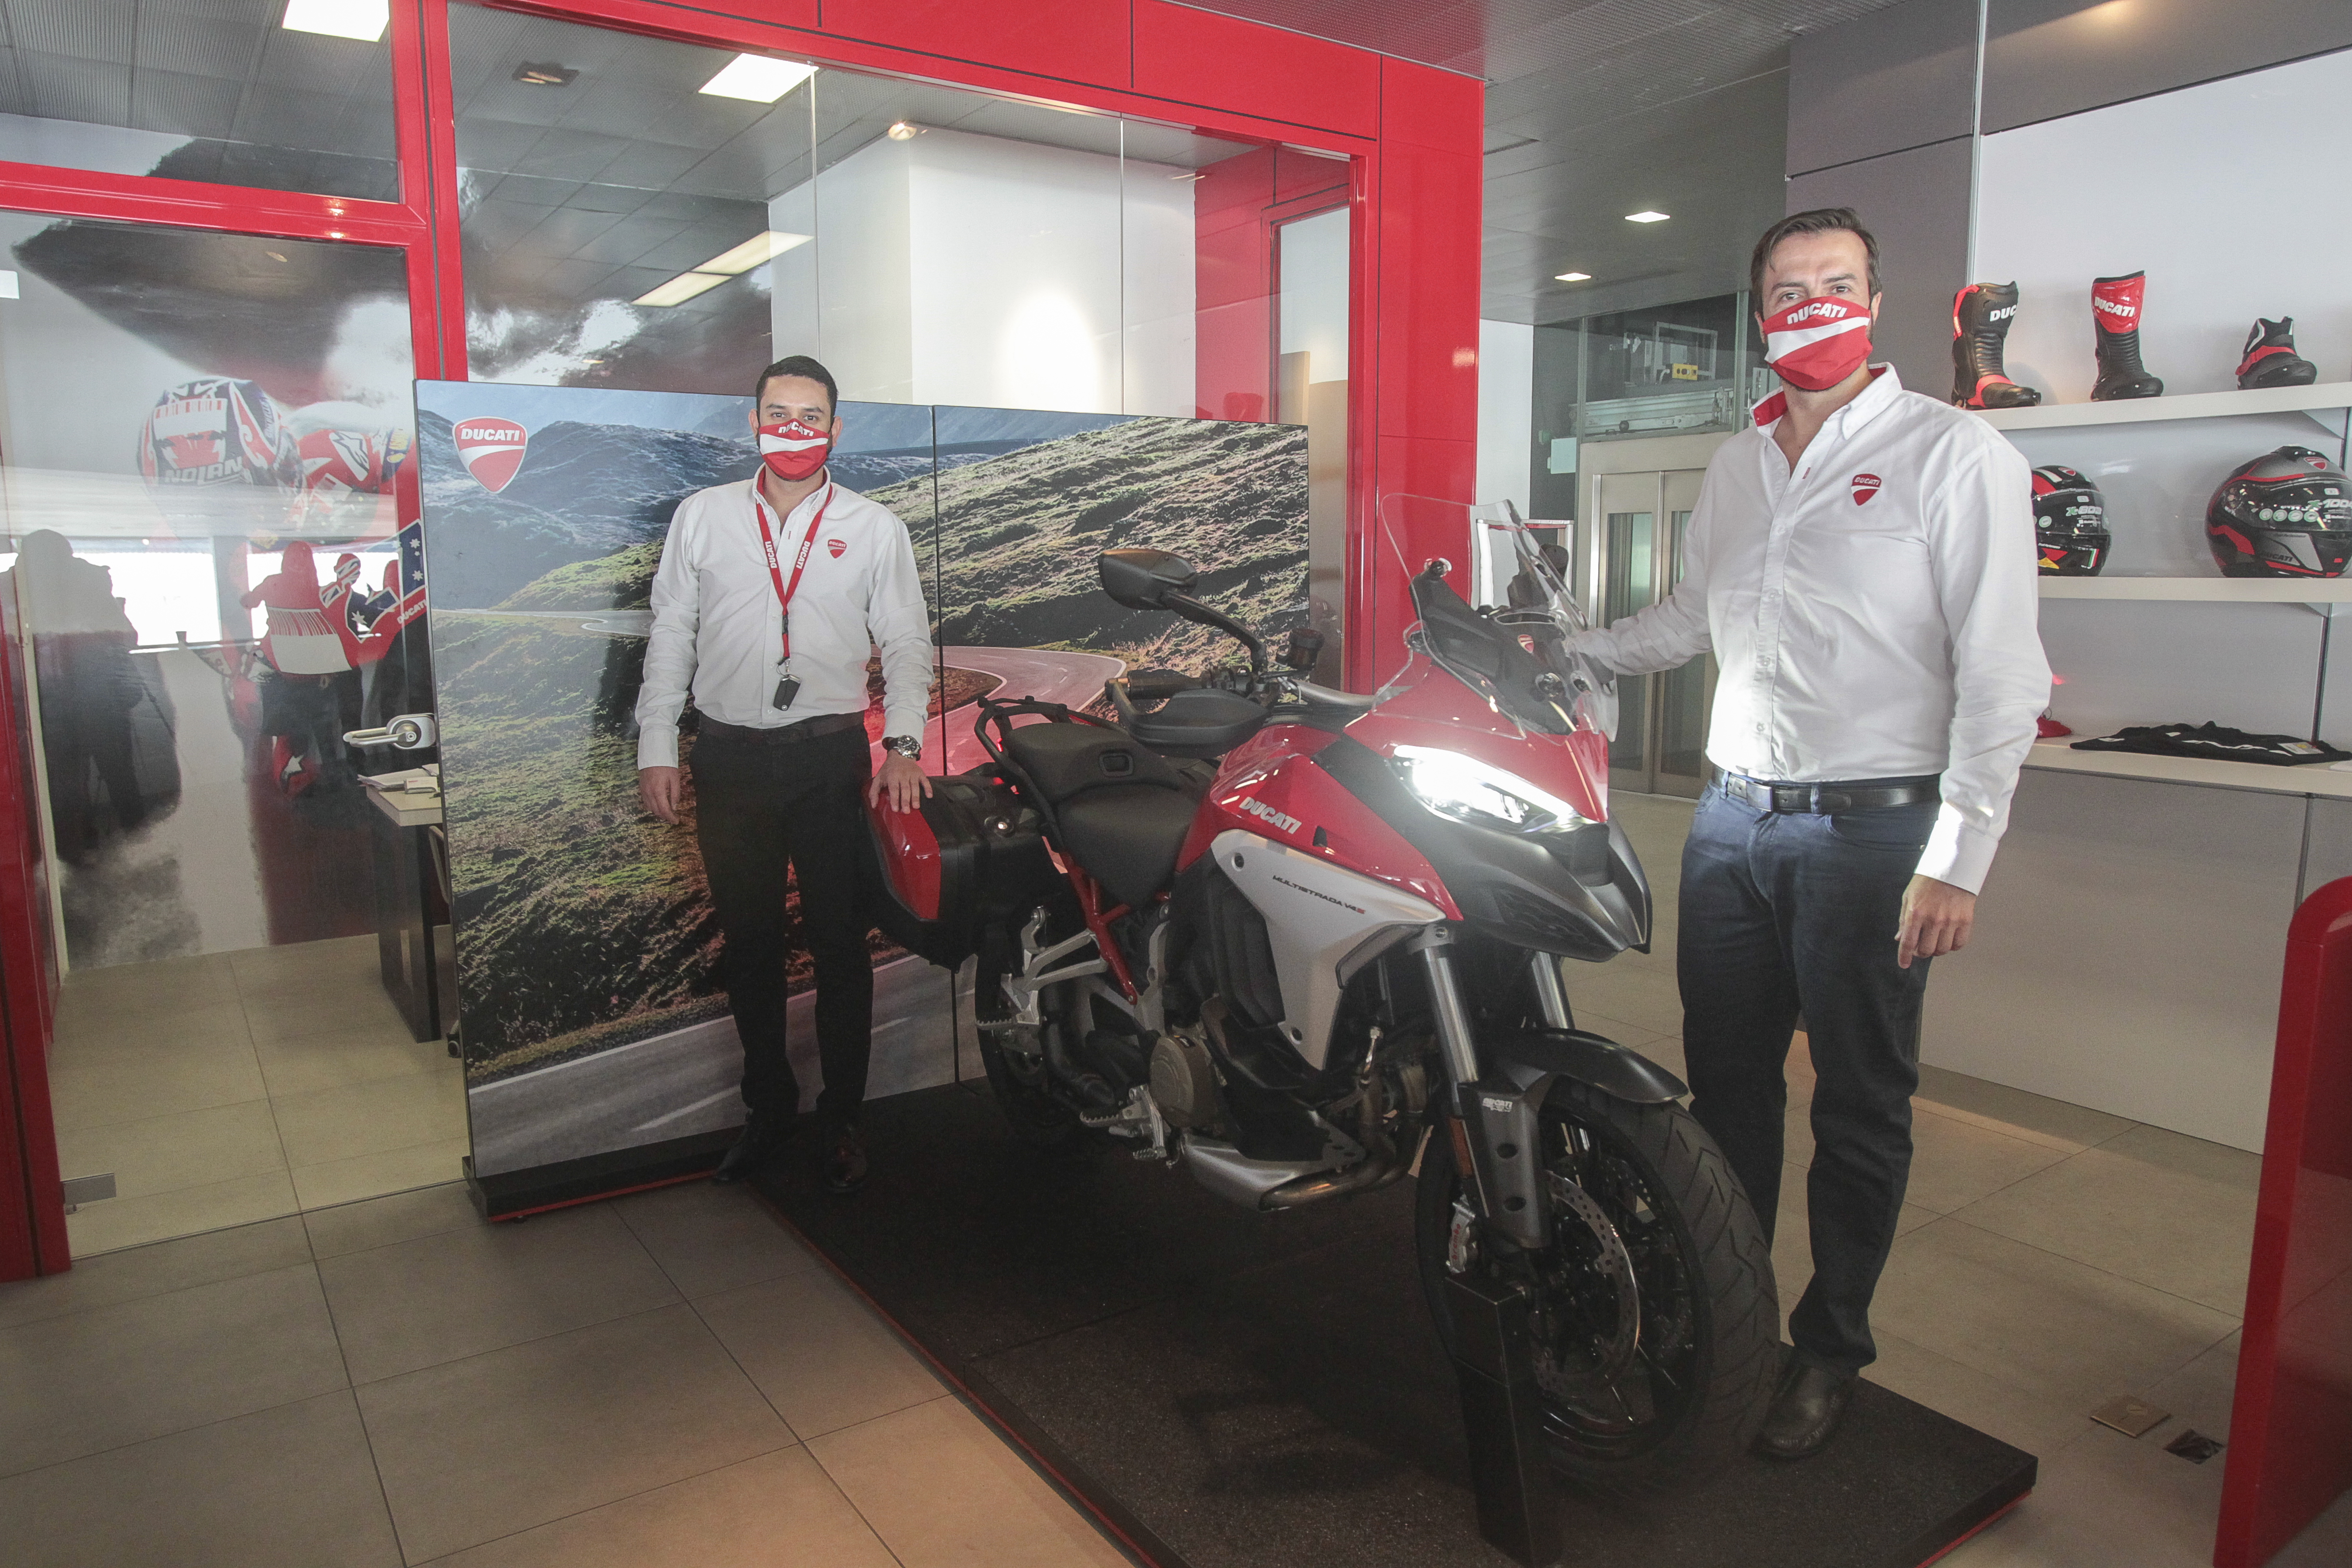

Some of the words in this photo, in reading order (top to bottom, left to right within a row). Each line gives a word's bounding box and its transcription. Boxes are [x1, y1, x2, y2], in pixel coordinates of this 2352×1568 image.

[1787, 303, 1848, 325] DUCATI
[2095, 296, 2135, 317] DUCATI
[461, 429, 520, 441] DUCATI
[778, 421, 814, 437] DUCATI
[1854, 477, 1880, 486] DUCATI
[765, 541, 777, 569] DUCATI
[796, 540, 811, 569] DUCATI
[1239, 796, 1302, 834] DUCATI
[1273, 875, 1343, 906] MULTISTRADA
